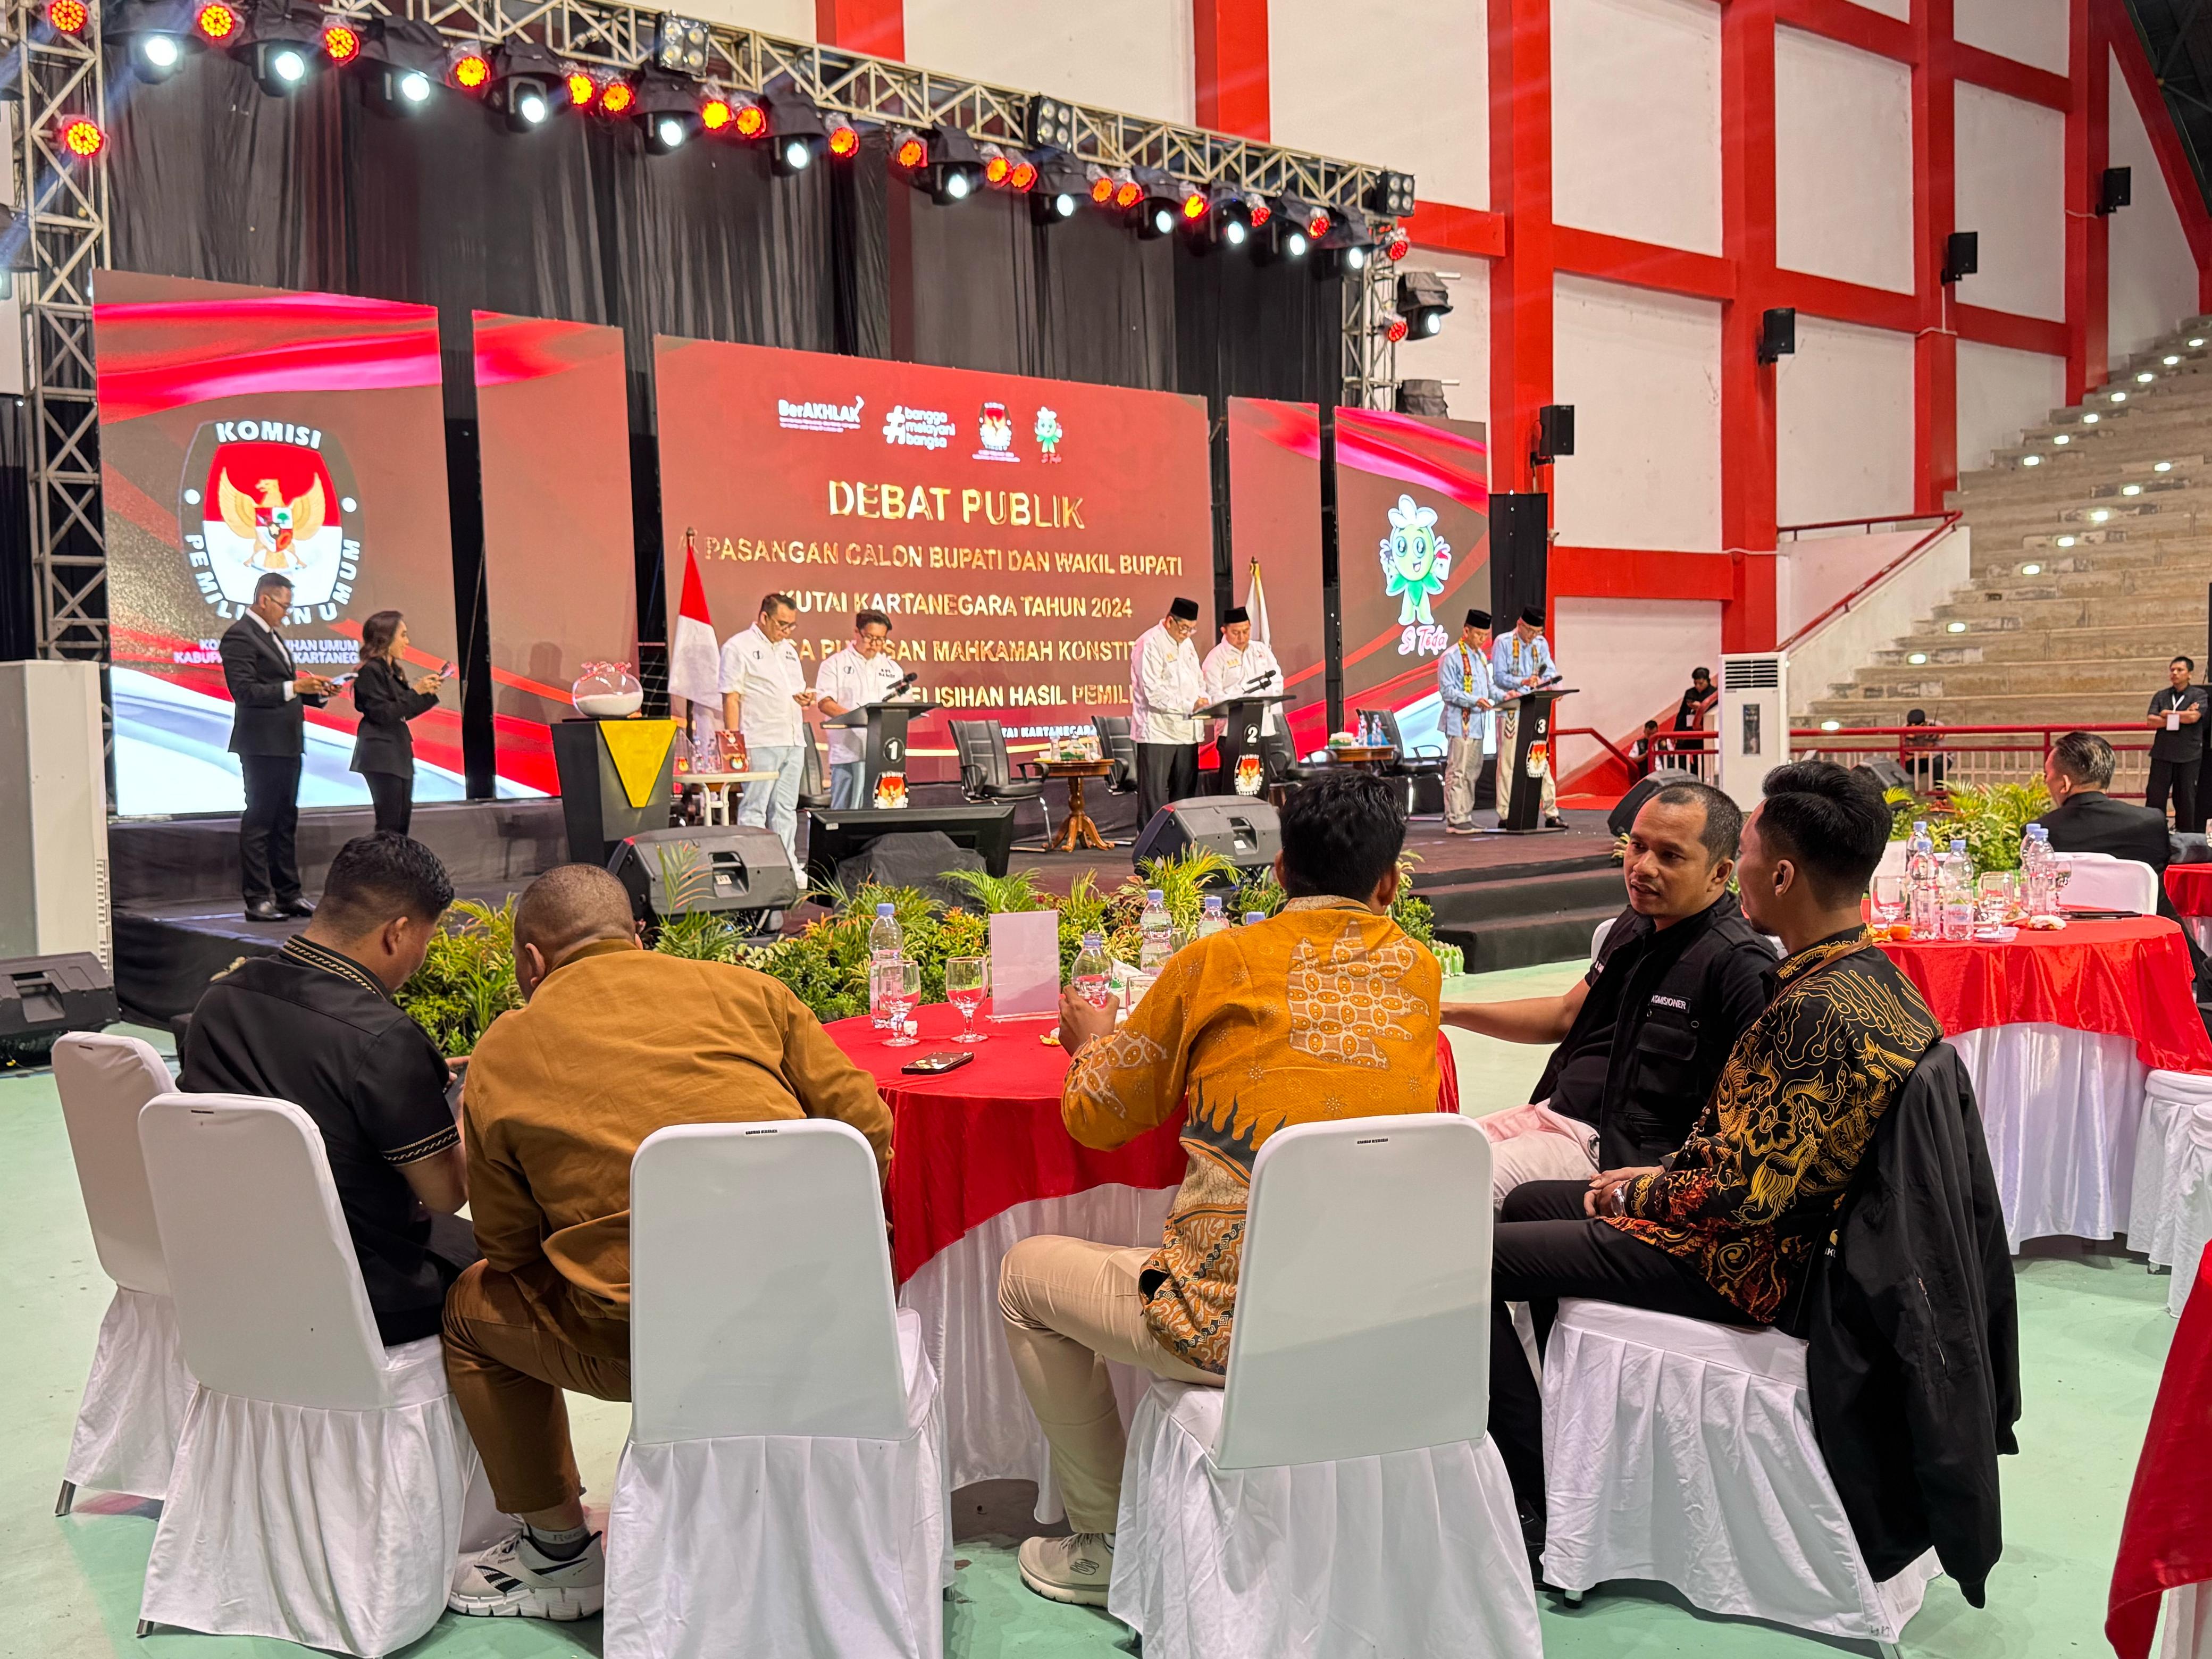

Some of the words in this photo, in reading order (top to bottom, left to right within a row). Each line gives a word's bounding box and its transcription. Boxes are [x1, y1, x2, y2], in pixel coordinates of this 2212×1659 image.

[216, 421, 321, 449] KOMISI
[828, 480, 951, 521] DEBAT
[962, 489, 1085, 530] PUBLIK
[705, 536, 839, 565] PASANGAN
[845, 542, 923, 568] CALON
[929, 546, 1002, 571] BUPATI
[1008, 550, 1050, 573] DAN
[1054, 552, 1116, 574] WAKIL
[1119, 554, 1183, 576] BUPATI
[853, 592, 1017, 617] KARTANEGARA
[1020, 595, 1086, 617] TAHUN
[1091, 597, 1133, 618] 2024
[319, 640, 359, 651] UMUM
[933, 640, 1053, 662] MAHKAMAH
[173, 650, 223, 664] KABUPA
[293, 651, 360, 664] KARTANEG
[1009, 684, 1068, 707] HASIL
[1073, 684, 1133, 705] PEMILI
[1001, 727, 1018, 738] TAI
[1246, 726, 1258, 743] 2
[1537, 718, 1546, 734] 3
[888, 741, 898, 760] 1
